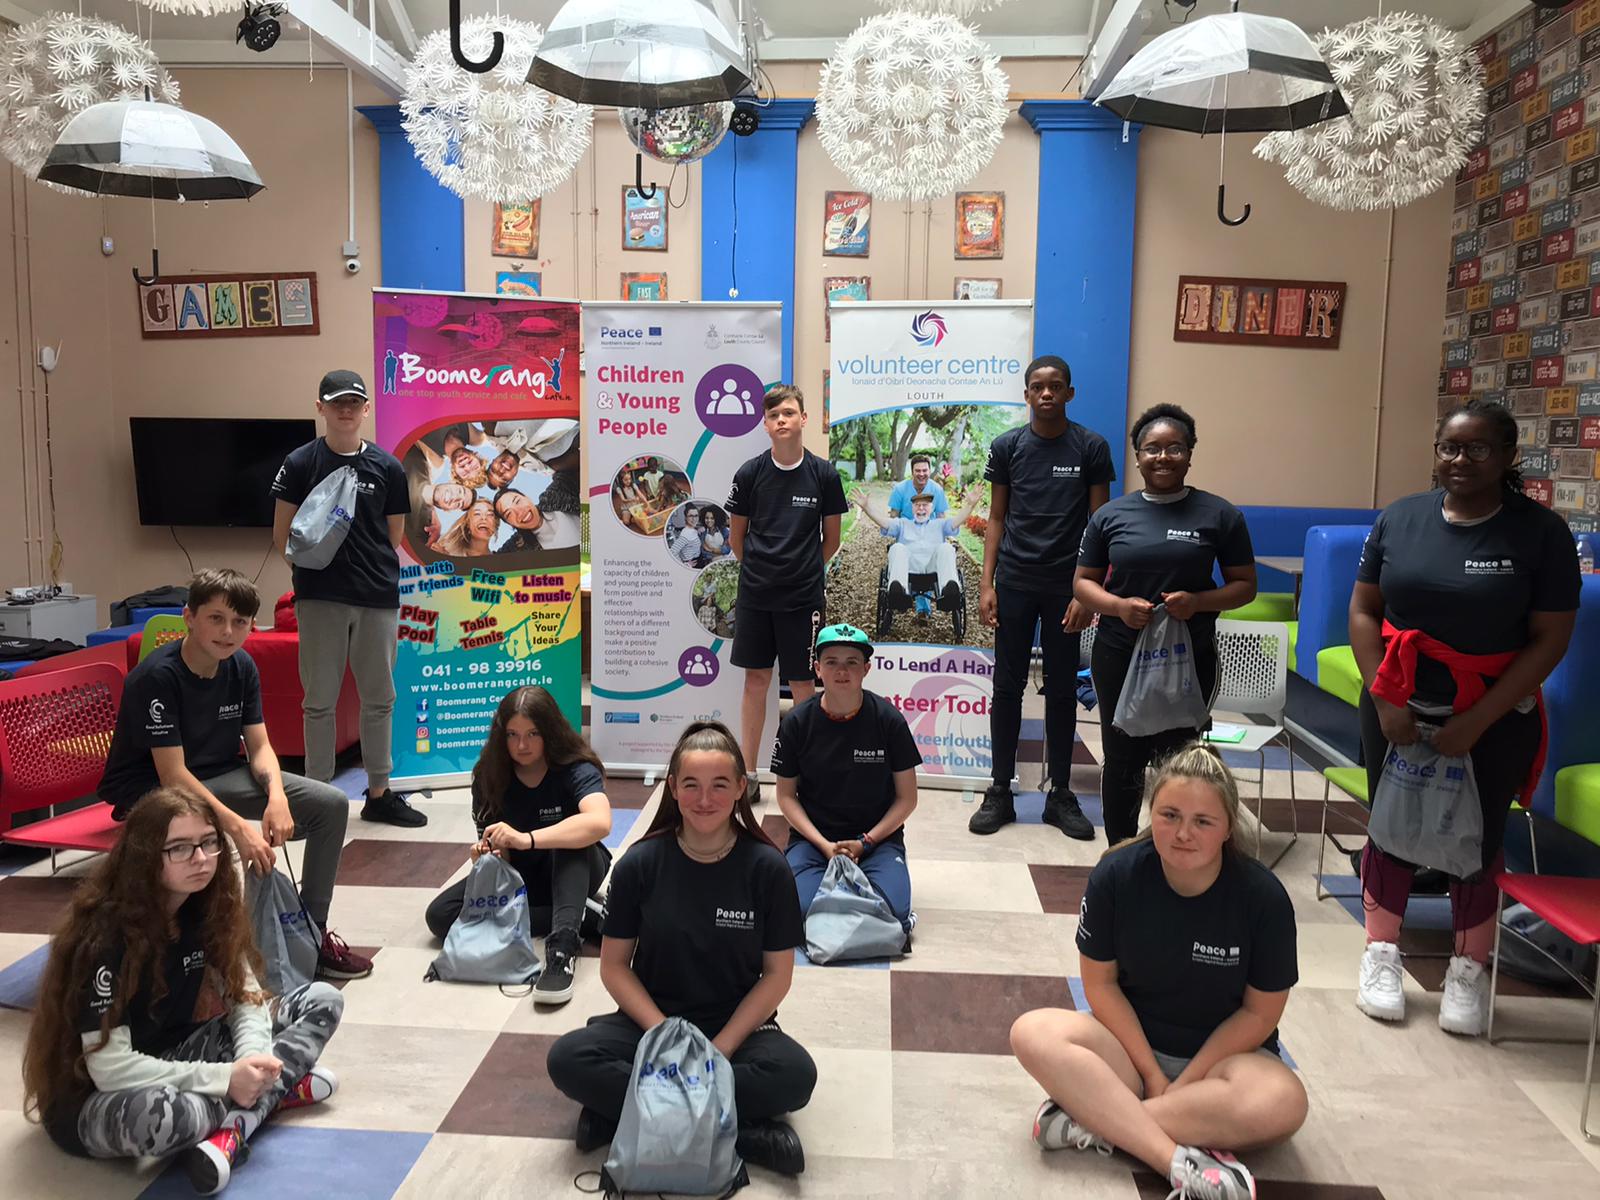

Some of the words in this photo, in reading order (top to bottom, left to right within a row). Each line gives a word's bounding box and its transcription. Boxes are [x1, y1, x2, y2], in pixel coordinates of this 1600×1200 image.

[1182, 286, 1337, 338] DINER
[601, 327, 643, 338] Peace
[837, 355, 942, 374] volunteer
[947, 355, 1020, 374] centre
[399, 352, 545, 398] Boomerang
[597, 365, 684, 383] Children
[416, 389, 434, 399] stop
[597, 391, 613, 409] &
[617, 392, 680, 413] Young
[908, 392, 944, 400] LOUTH
[598, 418, 667, 438] People
[400, 565, 421, 578] hill
[425, 561, 453, 575] with
[603, 560, 639, 568] Enhancing
[1465, 560, 1498, 568] Peace
[472, 569, 505, 585] Free
[522, 575, 564, 587] Listen
[603, 570, 632, 578] capacity
[418, 576, 464, 592] friends
[640, 580, 664, 588] people
[471, 588, 502, 604] Wifi
[514, 592, 529, 603] to
[532, 591, 572, 603] music
[621, 590, 647, 598] positive
[400, 605, 439, 626] Play
[531, 611, 561, 620] Share
[459, 616, 497, 634] Table
[534, 623, 558, 632] Your
[398, 625, 435, 643] Pool
[459, 630, 505, 650] Tennis
[533, 636, 560, 645] Ideas
[422, 665, 451, 677] 041
[469, 663, 490, 675] 98
[495, 660, 542, 673] 39916
[874, 656, 894, 670] To
[899, 657, 940, 672] Lend
[946, 660, 958, 673] A
[411, 676, 552, 693] www.boomerangcafe.ie
[436, 697, 486, 707] Boomerang
[716, 908, 747, 920] Peace
[1193, 941, 1226, 956] Peace
